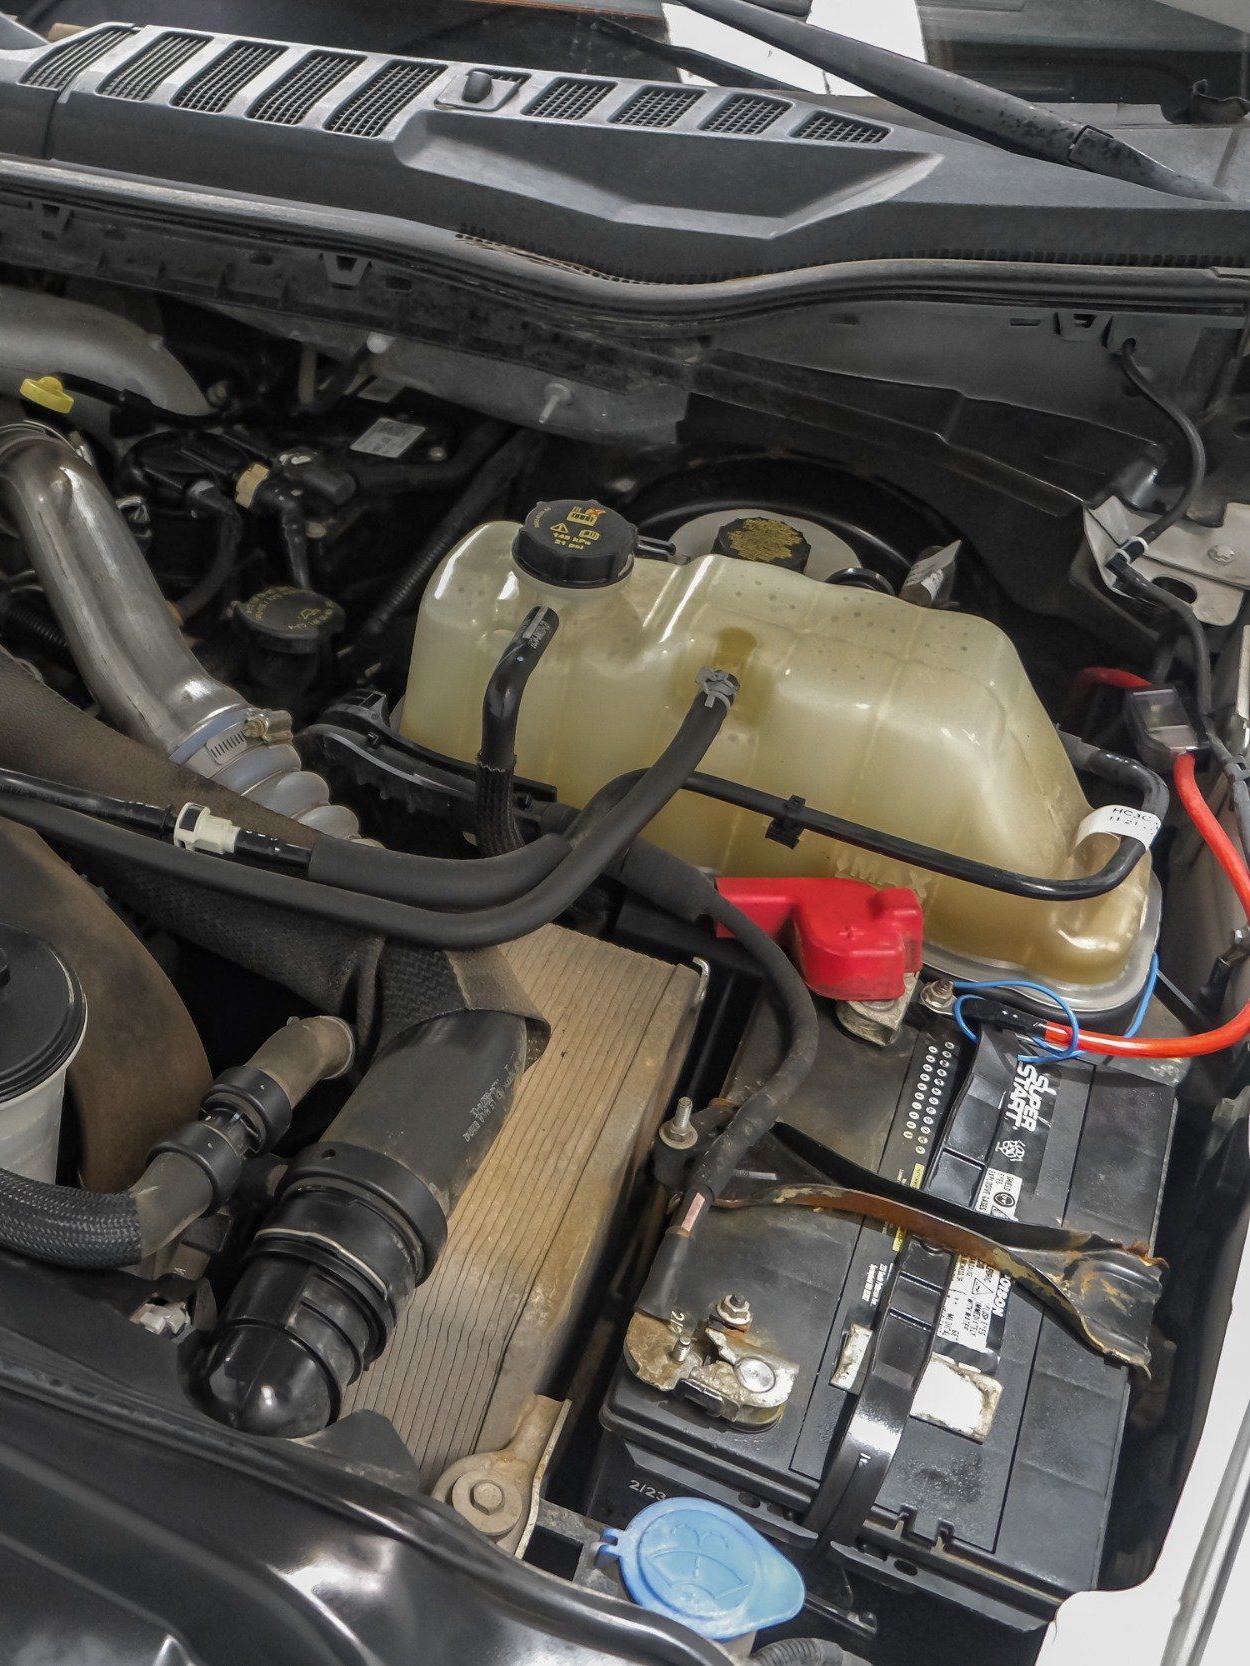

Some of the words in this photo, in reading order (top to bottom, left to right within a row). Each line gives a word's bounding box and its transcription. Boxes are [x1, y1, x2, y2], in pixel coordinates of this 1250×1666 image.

[1005, 1062, 1036, 1130] START
[1019, 1073, 1052, 1132] SUPER
[629, 1479, 667, 1500] 2/23
